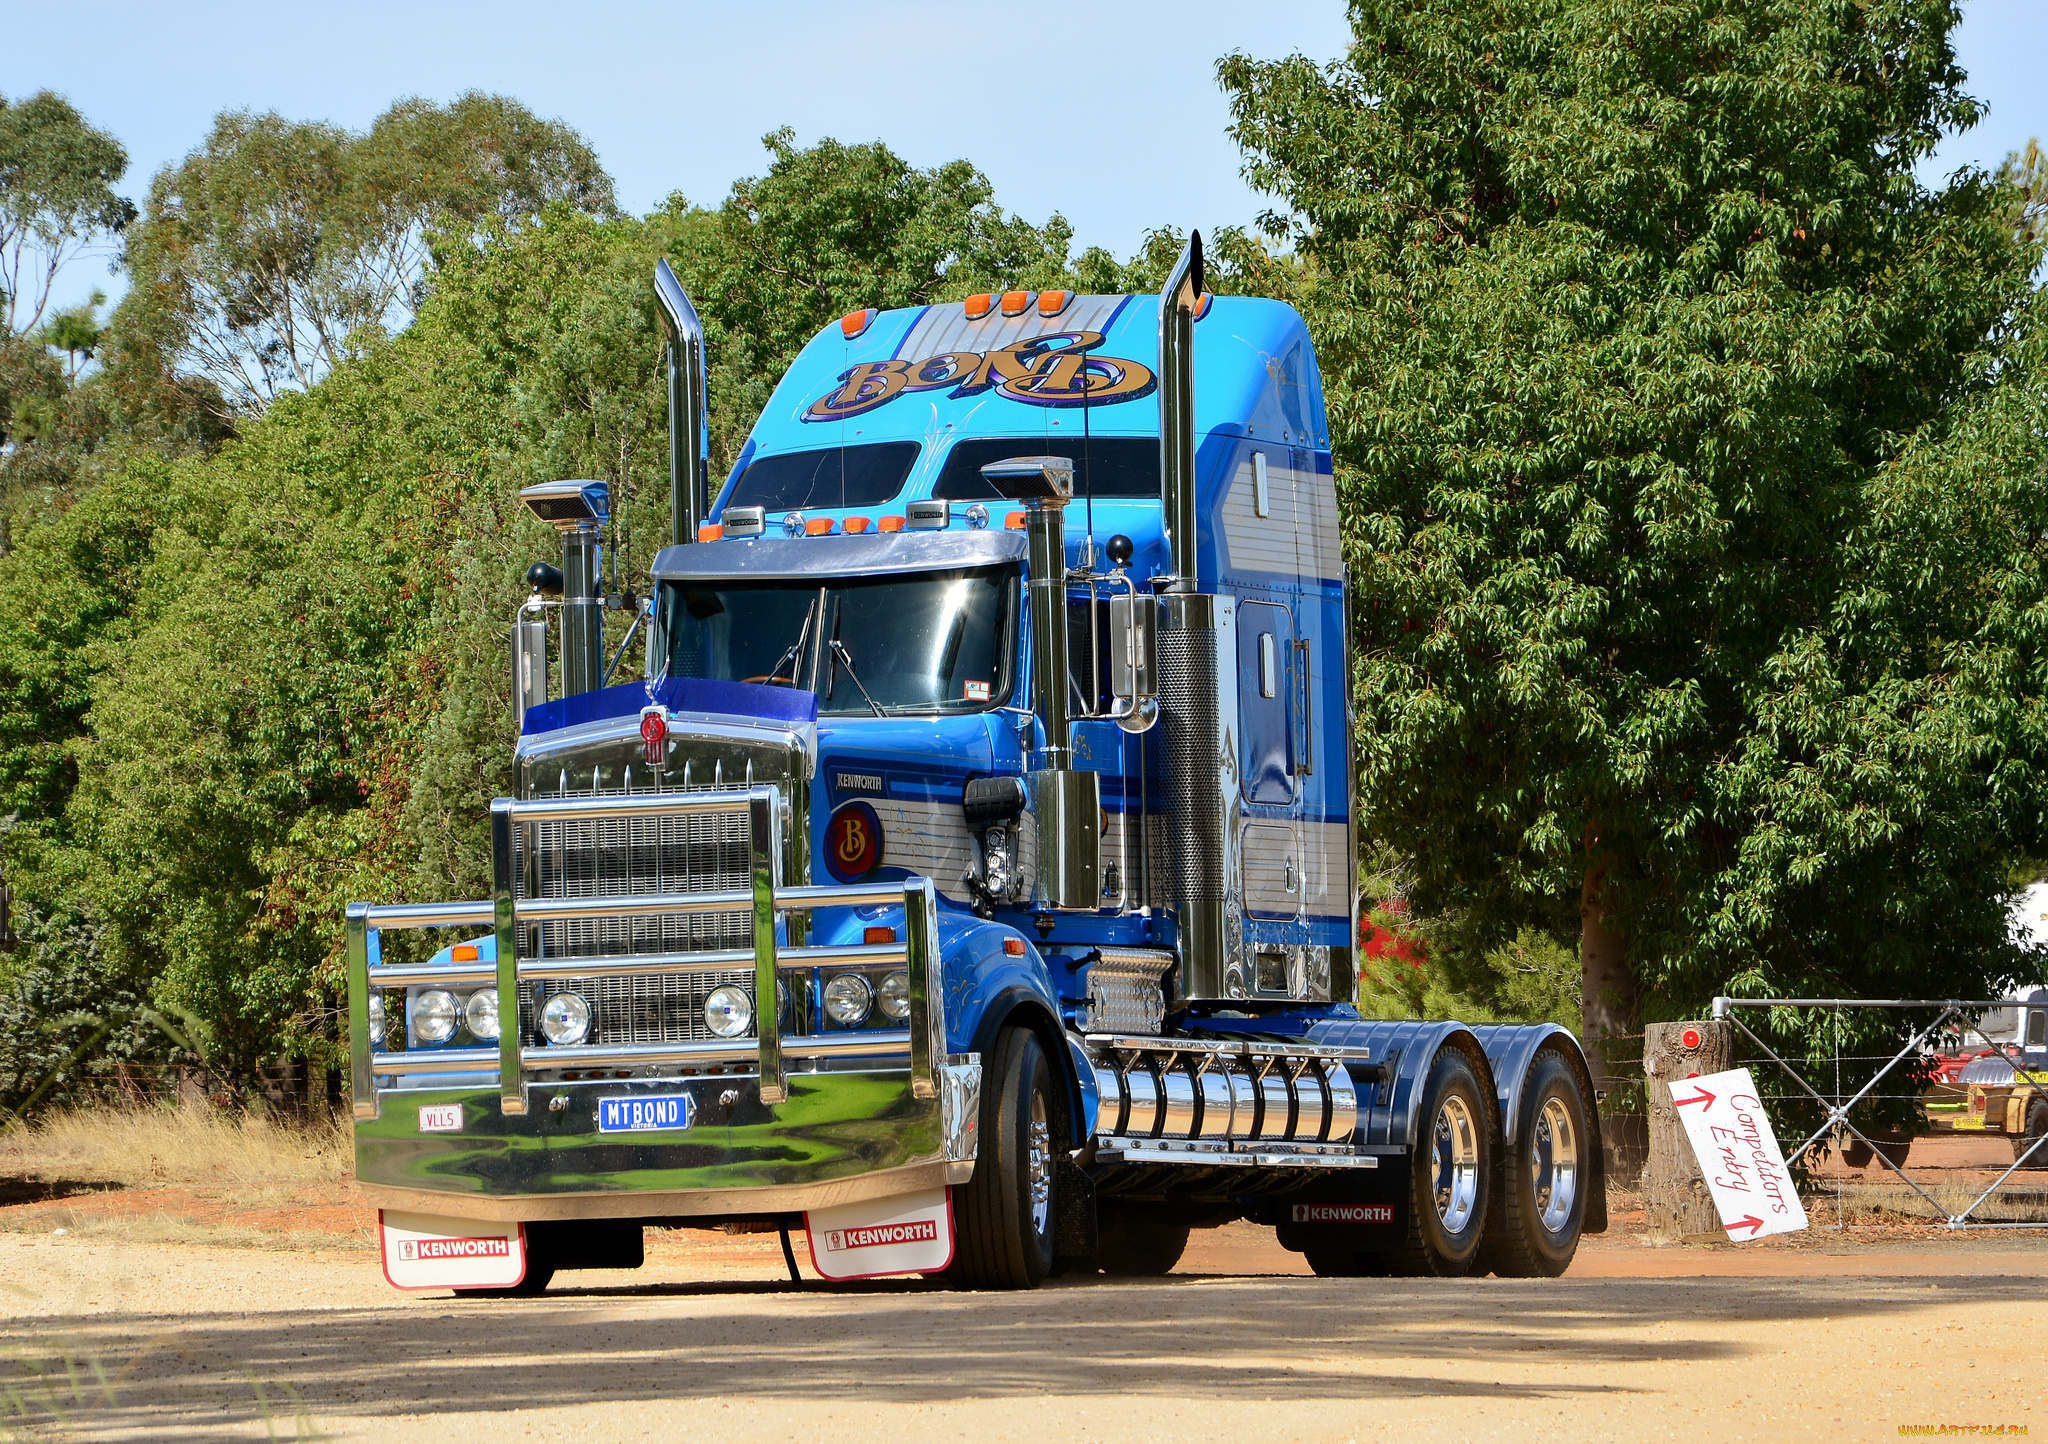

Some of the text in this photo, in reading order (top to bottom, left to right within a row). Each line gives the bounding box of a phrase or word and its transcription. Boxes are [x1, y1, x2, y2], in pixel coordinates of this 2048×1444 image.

[800, 330, 1158, 424] BOND
[836, 772, 882, 791] KENWORTH
[839, 819, 866, 862] B
[426, 1112, 454, 1127] VLLS
[607, 1100, 678, 1125] MTBOND
[1710, 1126, 1751, 1192] Entry
[1730, 1094, 1788, 1214] Competitors
[1311, 1207, 1392, 1220] KENWORTH
[846, 1223, 934, 1246] KENWORTH
[420, 1240, 507, 1257] KENWORTH
